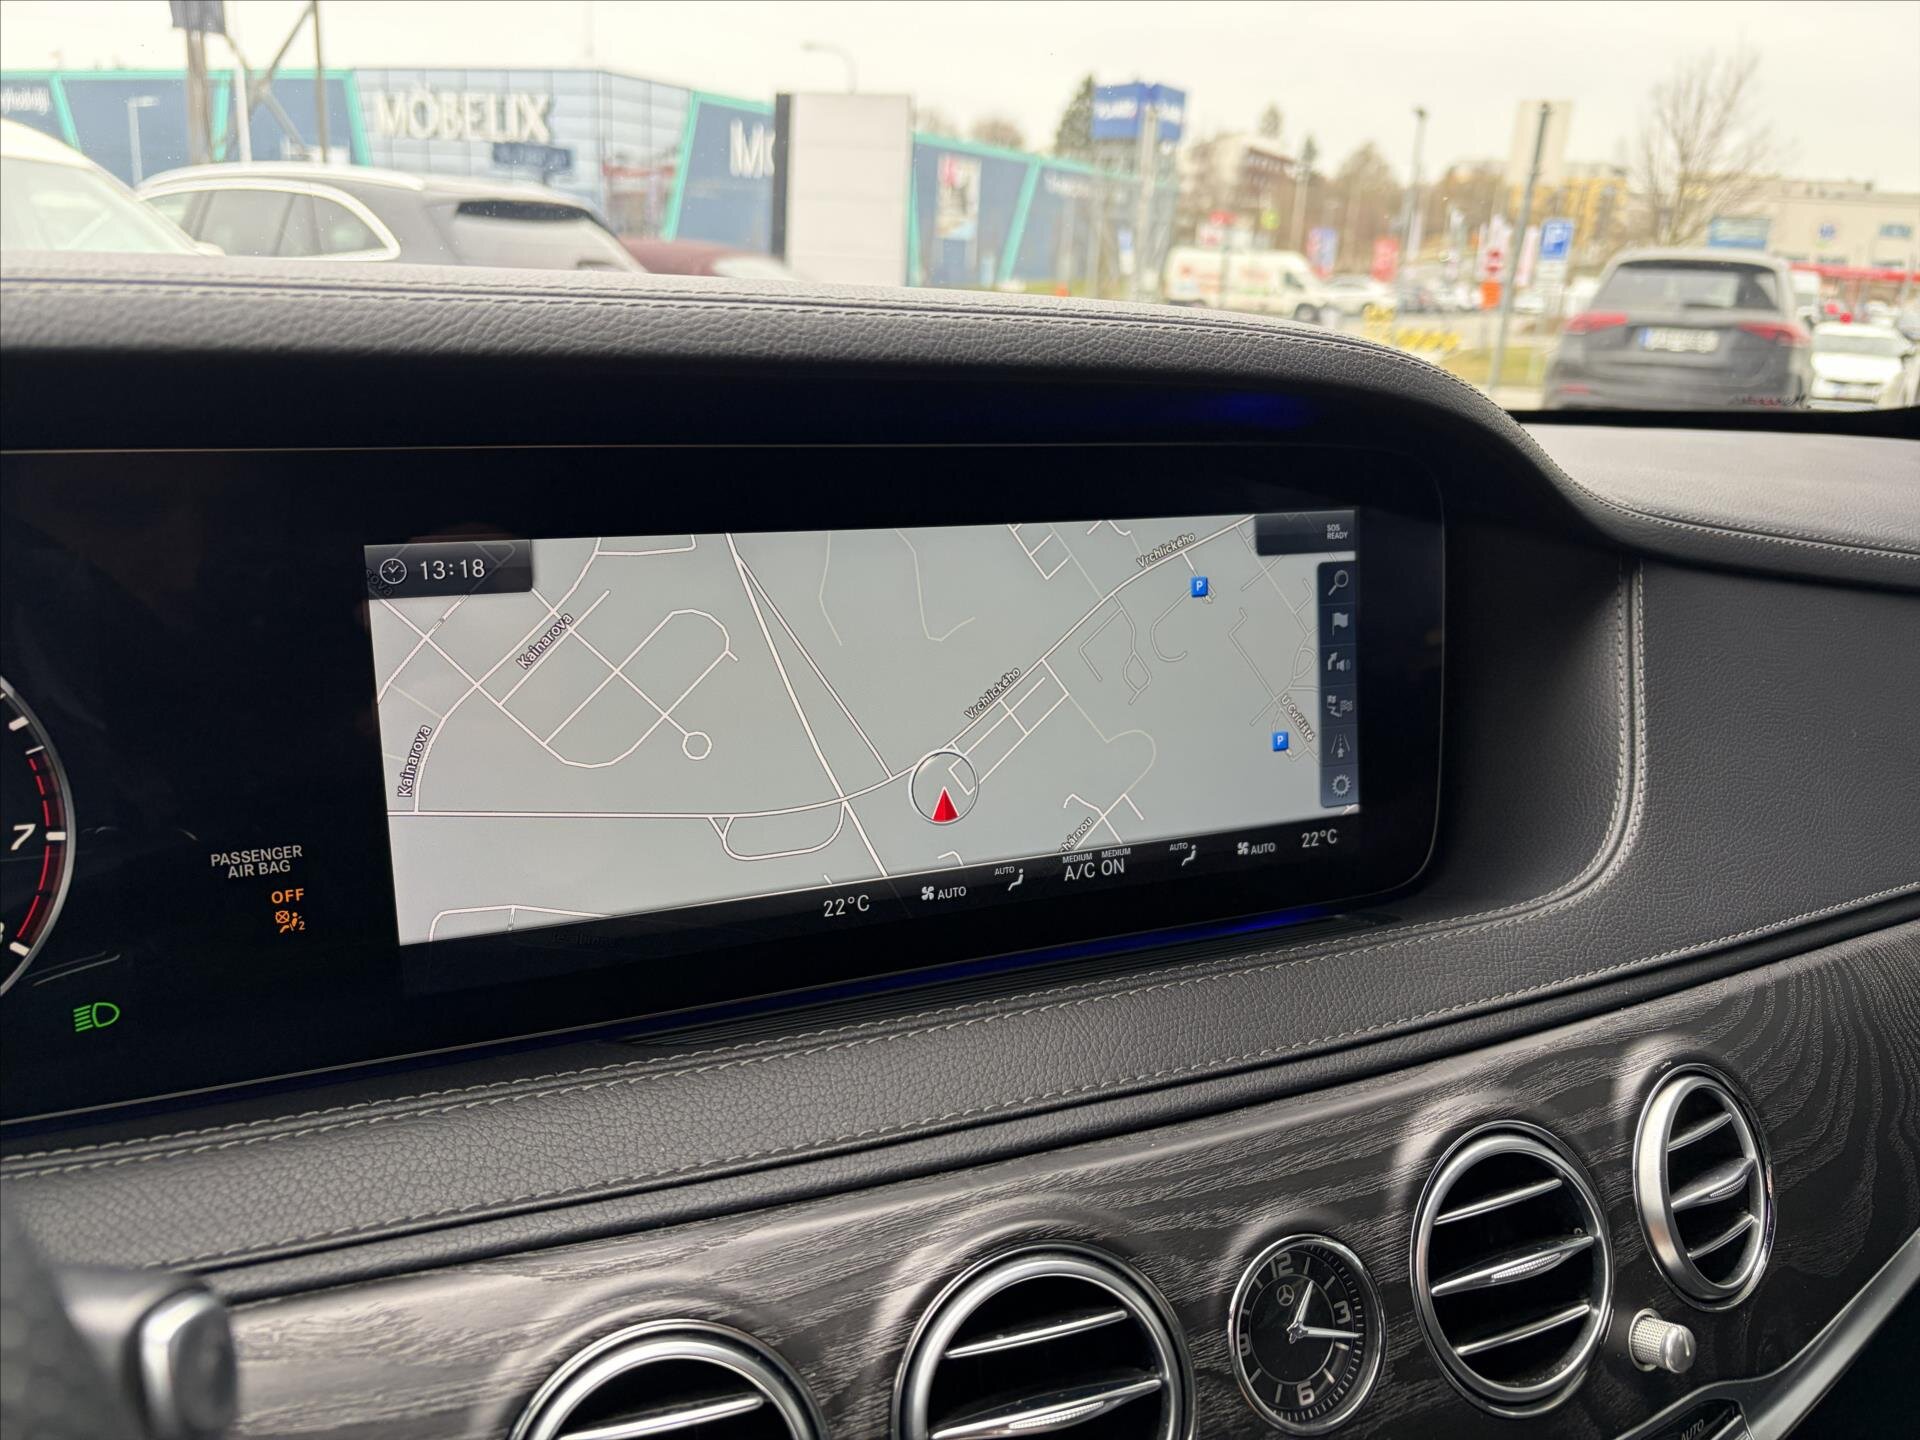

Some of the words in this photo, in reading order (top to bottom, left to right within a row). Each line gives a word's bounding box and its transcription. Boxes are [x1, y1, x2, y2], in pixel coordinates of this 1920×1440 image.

[1327, 532, 1348, 540] READY
[1137, 533, 1196, 568] Vrchlického
[420, 559, 485, 580] 13:18
[516, 613, 574, 670] Kainarova
[964, 667, 1021, 719] Vrchlického
[398, 725, 432, 797] Kainarova
[11, 824, 36, 850] 7
[1169, 842, 1188, 851] AUTO
[1301, 829, 1338, 848] 22°C
[210, 845, 303, 867] PASSENGER
[1062, 853, 1093, 863] MEDIUM
[1101, 847, 1132, 858] MEDIUM
[1250, 842, 1276, 855] AUTO
[228, 864, 255, 879] AIR
[259, 860, 291, 875] BAG
[994, 866, 1015, 876] AUTO
[1063, 862, 1096, 882] A/C
[1101, 858, 1125, 876] ON
[271, 888, 305, 904] OFF
[937, 886, 967, 900] AUTO
[823, 894, 870, 917] 22°C
[1270, 1252, 1294, 1279] 12
[1334, 1300, 1351, 1324] 3
[1297, 1381, 1315, 1406] 6
